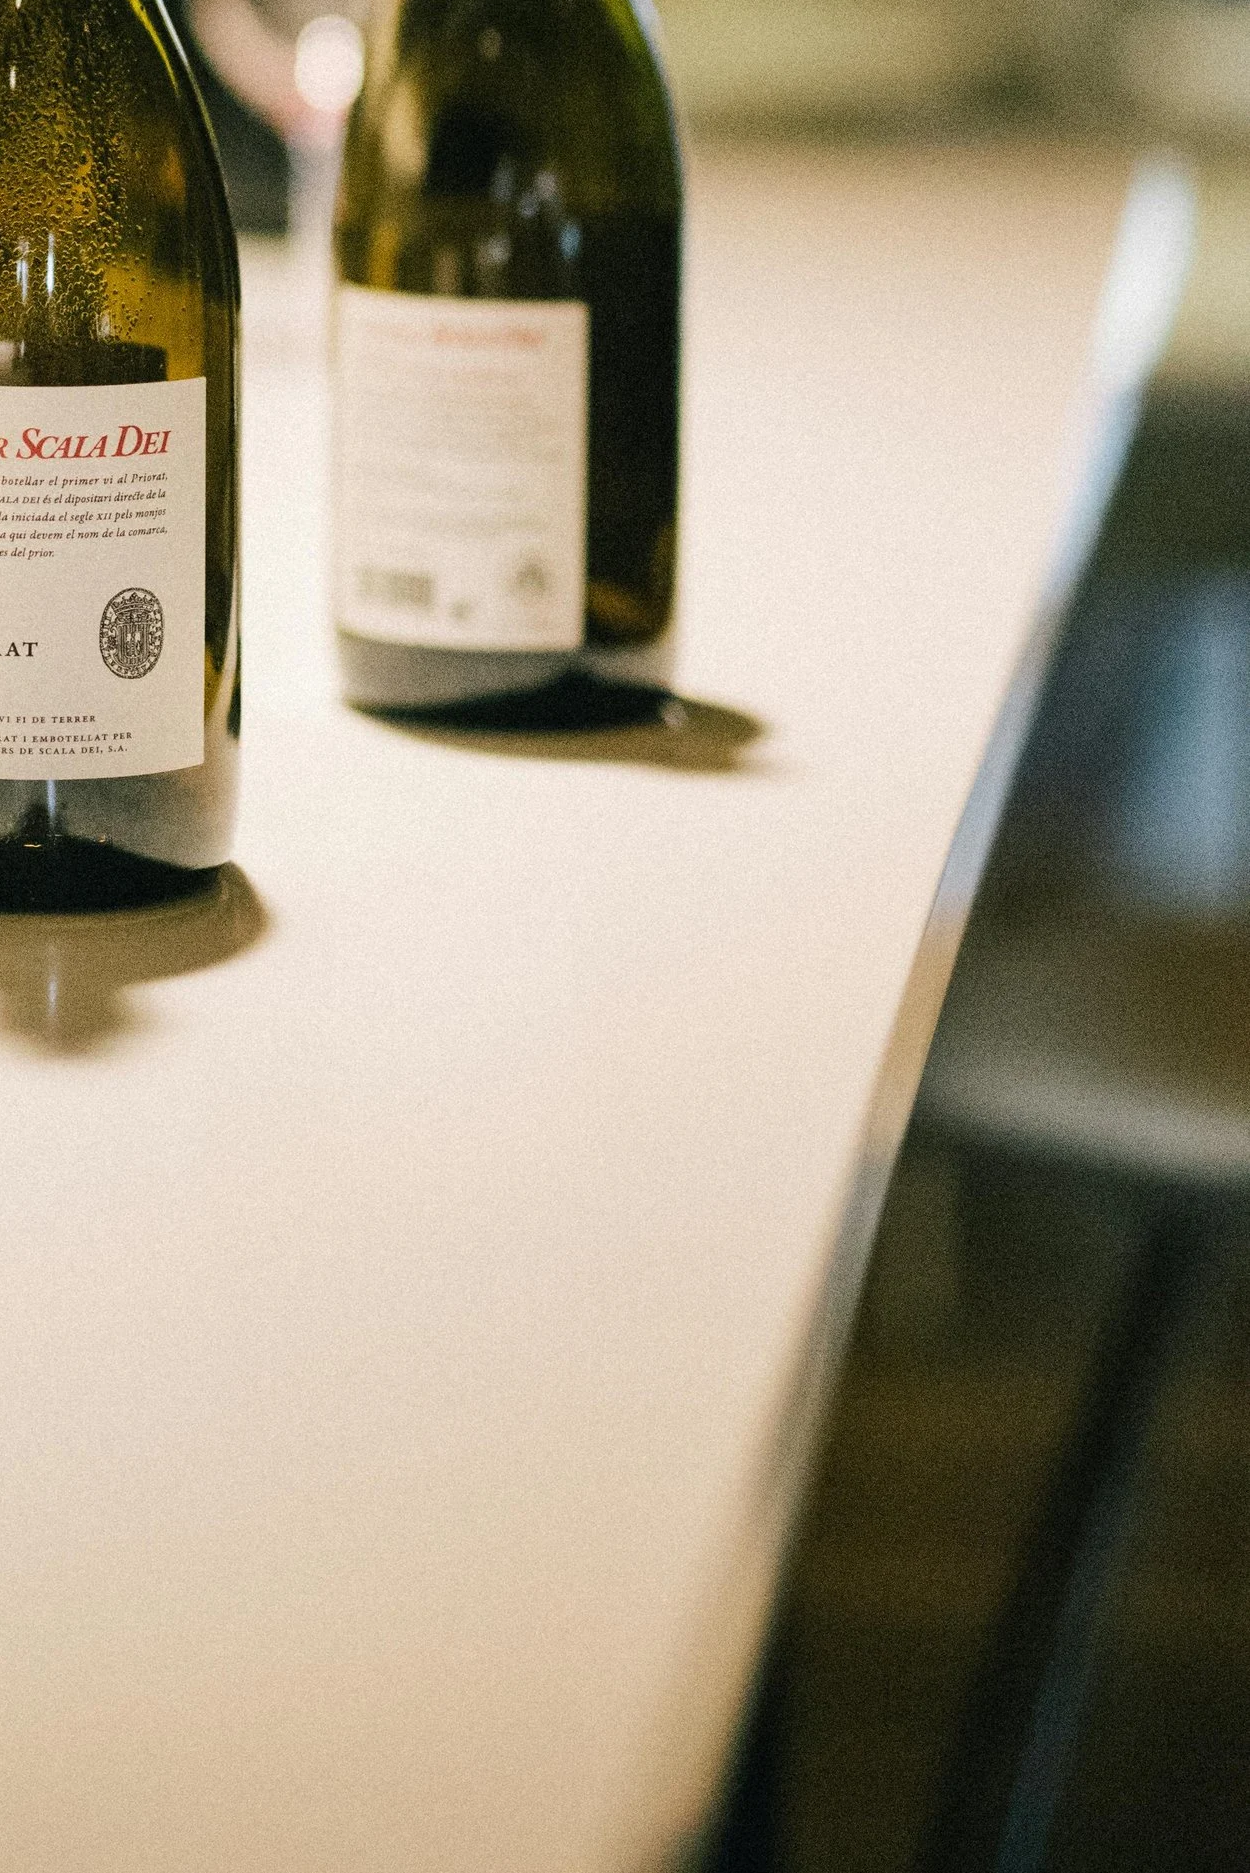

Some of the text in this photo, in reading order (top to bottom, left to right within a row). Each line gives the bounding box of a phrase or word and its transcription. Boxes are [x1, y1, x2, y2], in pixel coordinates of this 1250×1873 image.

[16, 427, 109, 459] SCALA
[111, 424, 171, 458] DEI
[48, 474, 58, 486] el
[61, 476, 99, 488] primer
[103, 475, 113, 485] vi
[117, 473, 128, 484] al
[131, 472, 168, 483] Priorat,
[22, 495, 40, 504] DEI
[42, 494, 52, 504] és
[54, 493, 63, 504] el
[65, 492, 112, 505] dipositari
[114, 491, 145, 503] directe
[146, 489, 156, 500] de
[157, 488, 166, 498] la
[11, 510, 56, 522] iniciada
[58, 510, 68, 522] el
[70, 511, 94, 524] segle
[96, 511, 112, 521] XII
[114, 509, 133, 522] pels
[135, 507, 166, 520] monjos
[0, 531, 6, 539] a
[9, 530, 27, 542] qui
[30, 528, 63, 540] devem
[65, 528, 75, 540] el
[78, 531, 99, 539] nom
[102, 526, 114, 538] de
[116, 525, 125, 537] la
[128, 525, 168, 537] comarca,
[11, 546, 26, 557] del
[27, 548, 55, 560] prior.
[32, 716, 45, 724] DE
[51, 714, 96, 724] TERRER
[23, 733, 27, 743] I
[32, 733, 108, 743] EMBOTELLAT
[112, 732, 132, 741] PER
[20, 746, 34, 755] DE
[39, 746, 75, 755] SCALA
[81, 746, 103, 756] DEI,
[108, 745, 128, 754] S.A.
